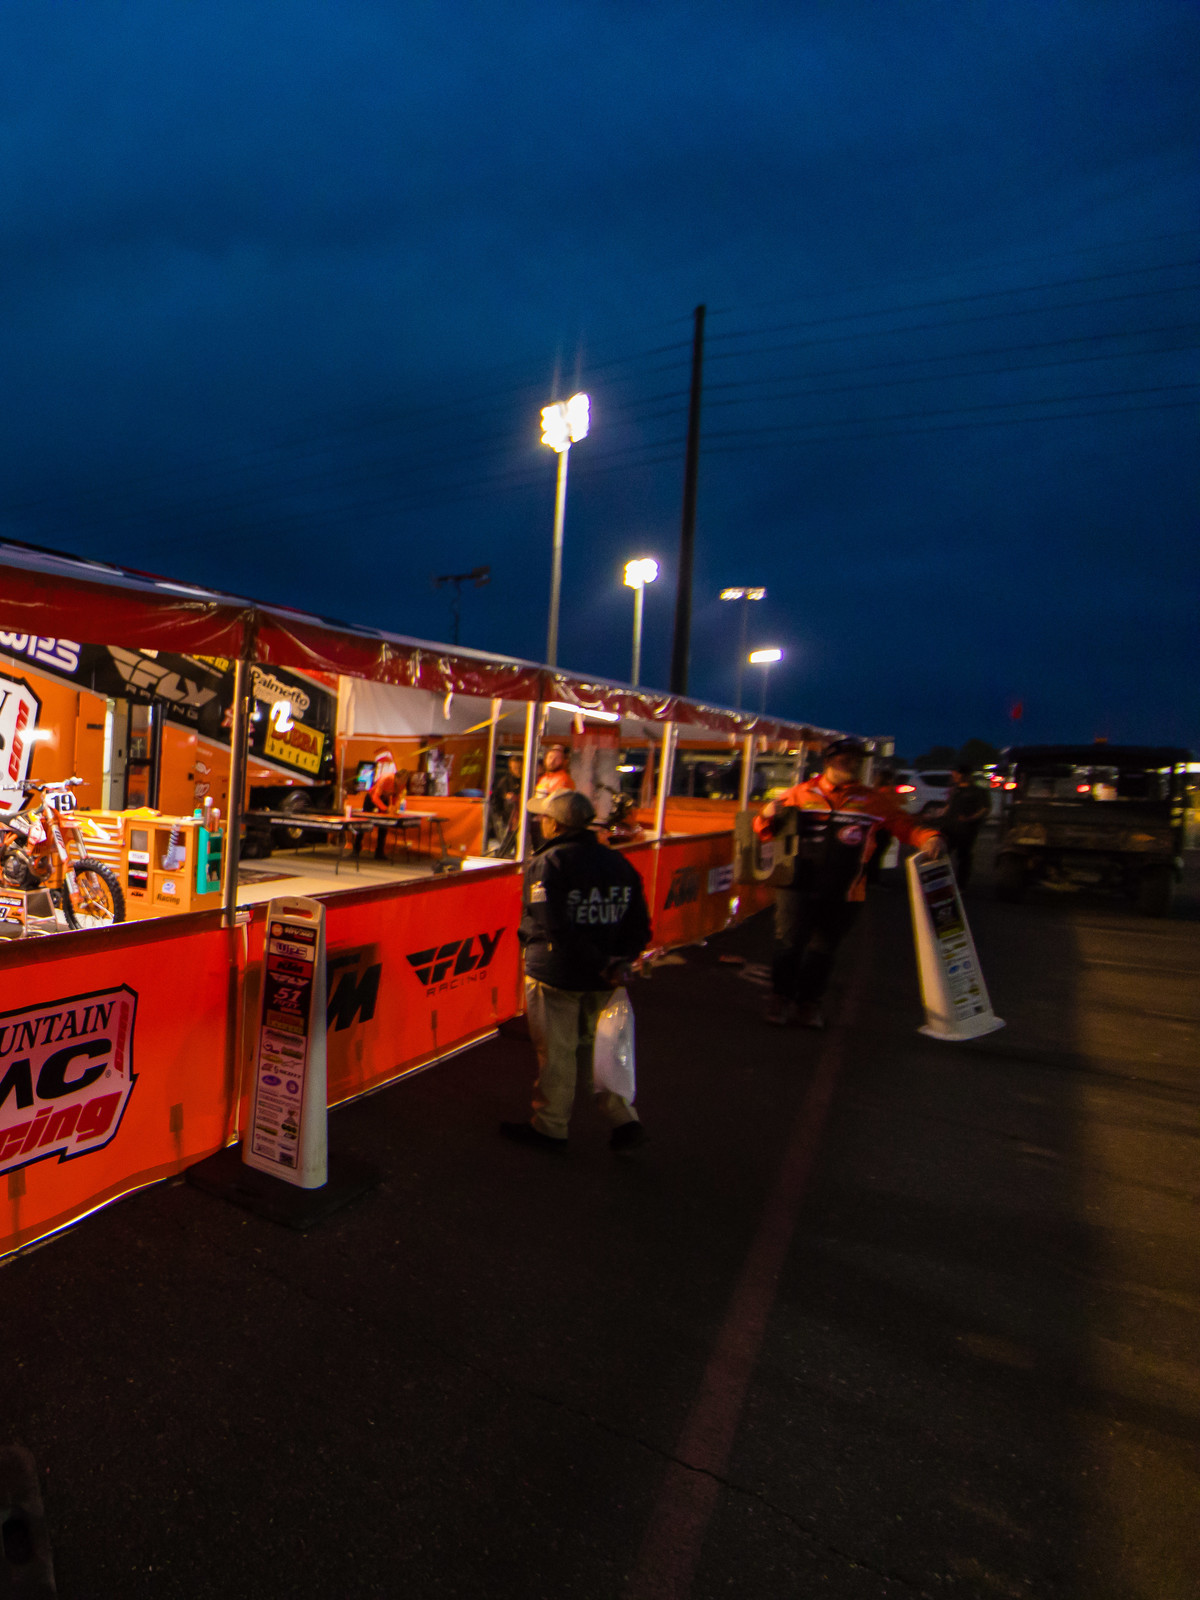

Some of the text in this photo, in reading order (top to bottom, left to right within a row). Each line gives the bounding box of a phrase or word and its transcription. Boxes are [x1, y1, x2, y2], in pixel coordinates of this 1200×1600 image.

[51, 794, 74, 812] 19
[406, 926, 506, 986] FLY
[426, 969, 488, 998] RACING
